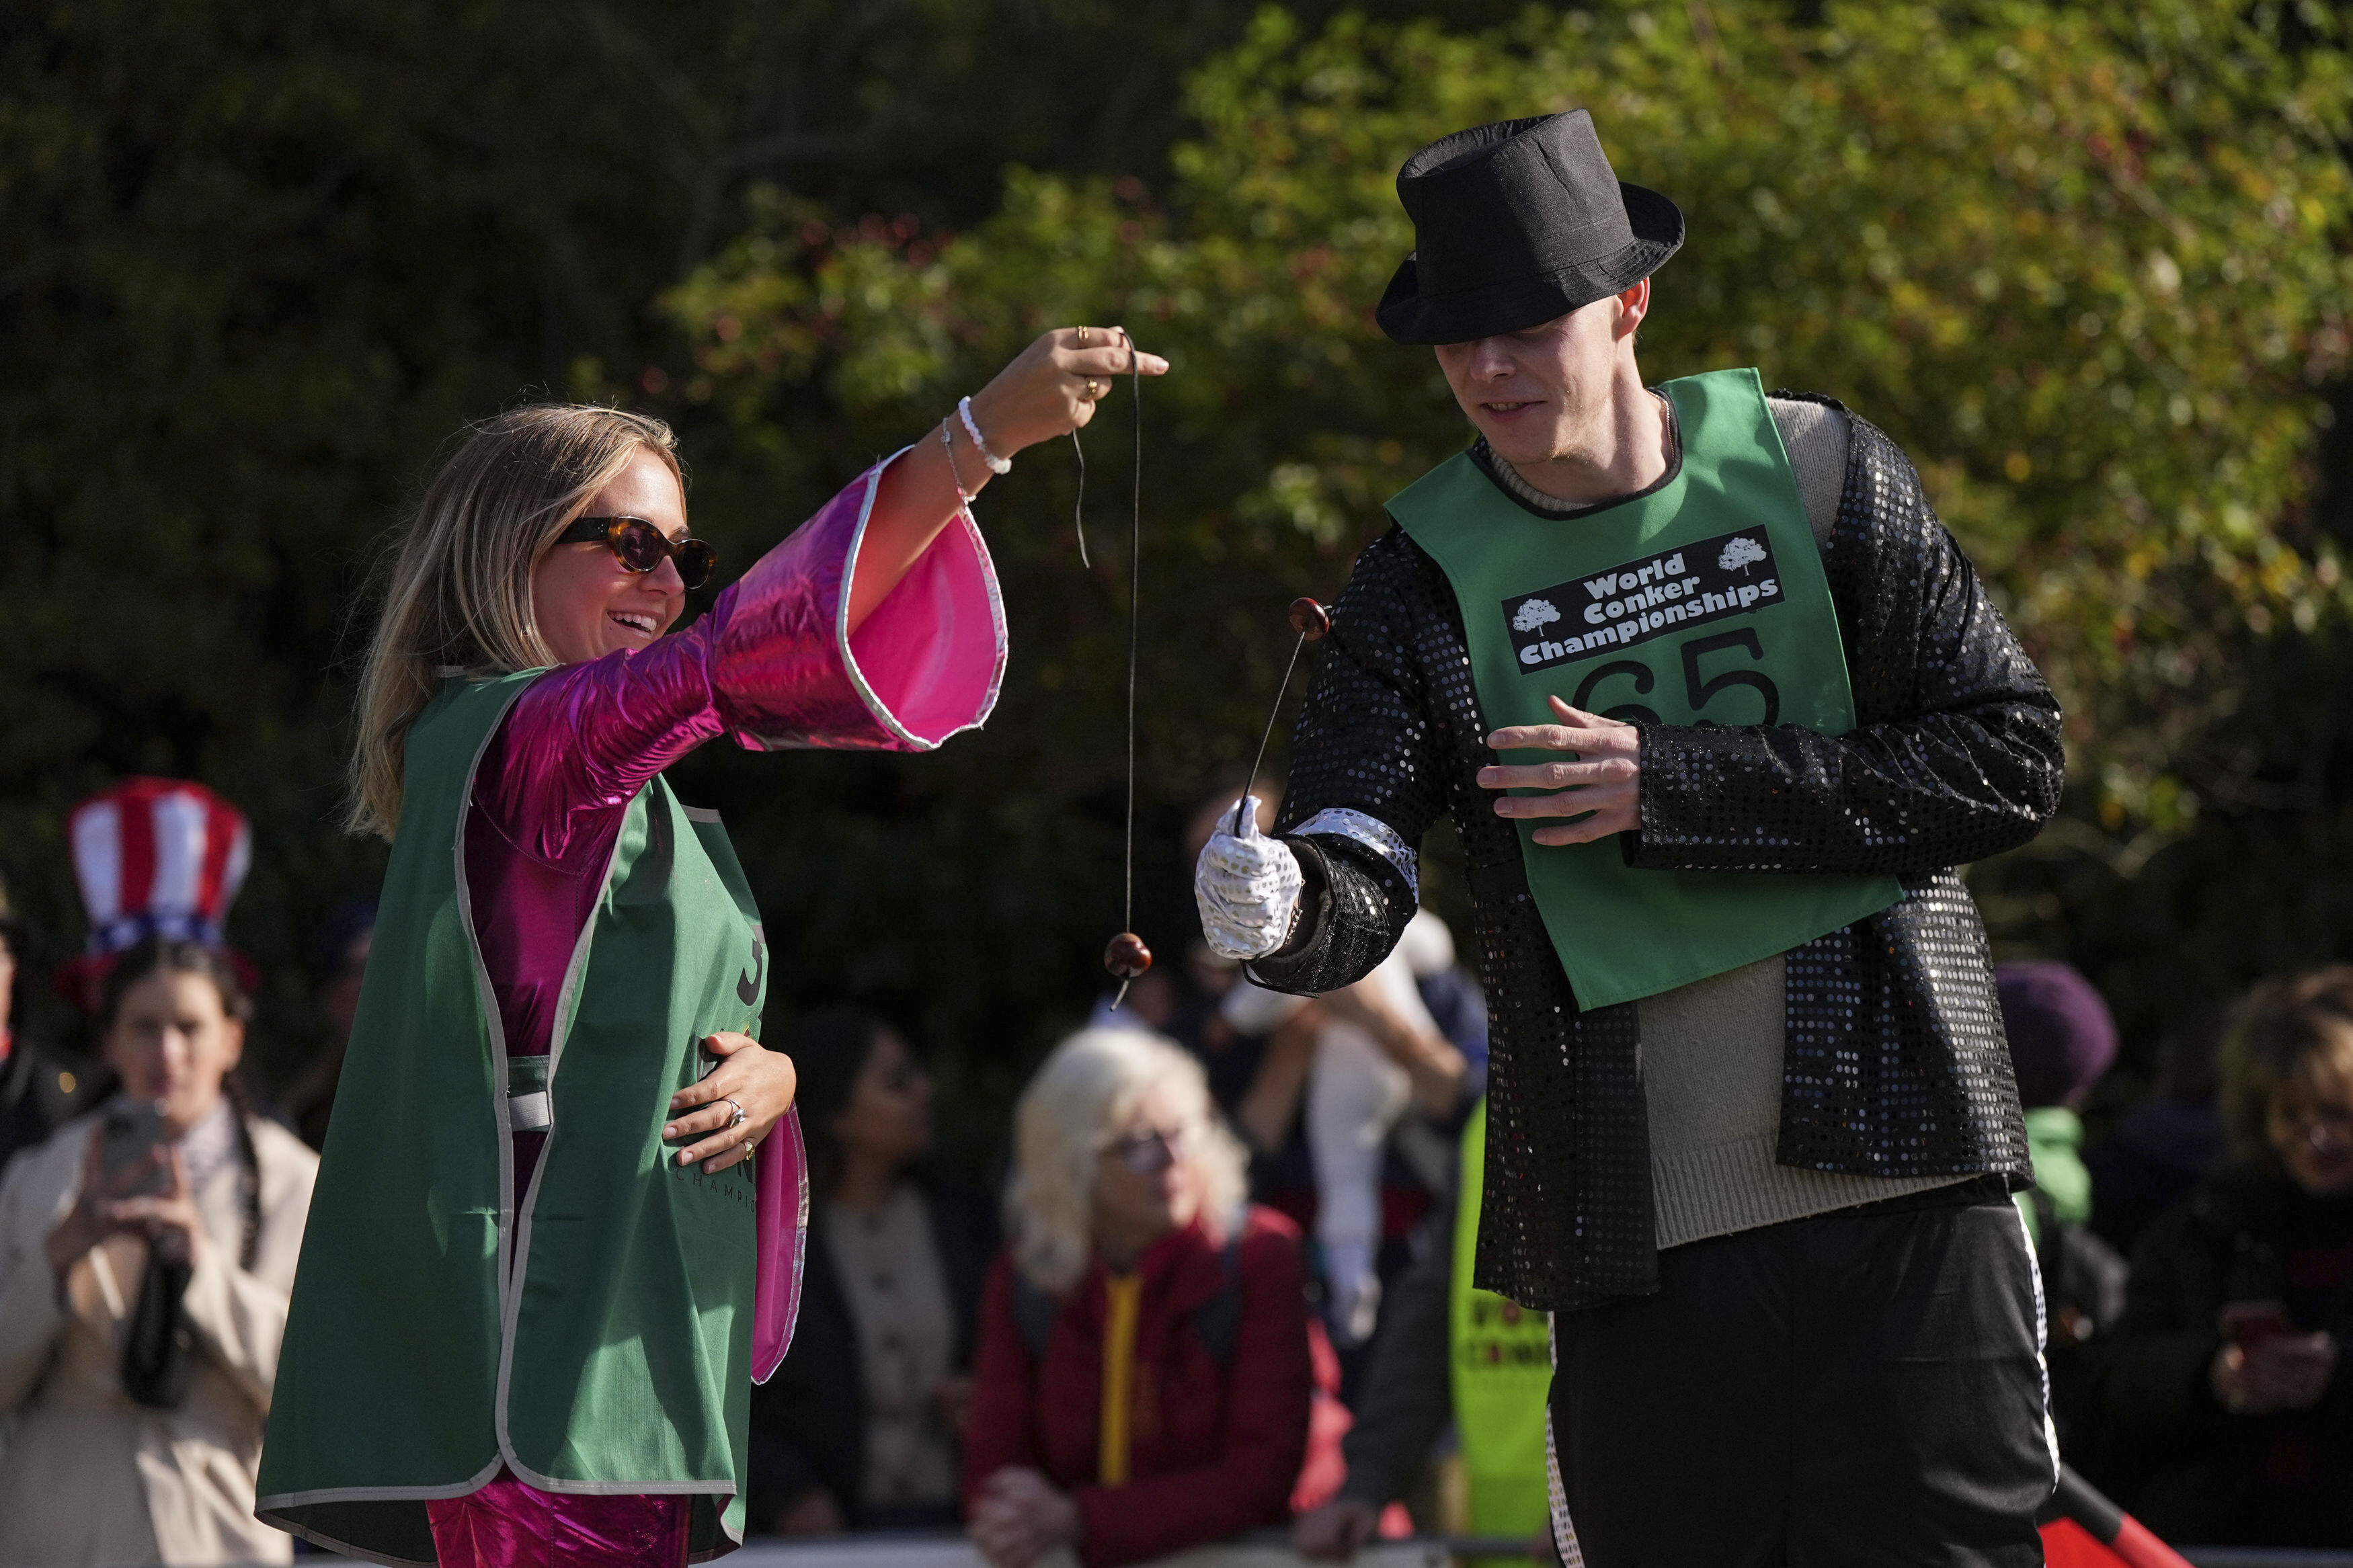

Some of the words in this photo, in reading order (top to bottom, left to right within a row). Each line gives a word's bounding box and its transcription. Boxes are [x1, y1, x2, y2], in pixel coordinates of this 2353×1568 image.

[1583, 552, 1686, 601] World
[1583, 577, 1701, 625] Conker
[1519, 578, 1779, 665] Championships
[1572, 626, 1780, 727] 65
